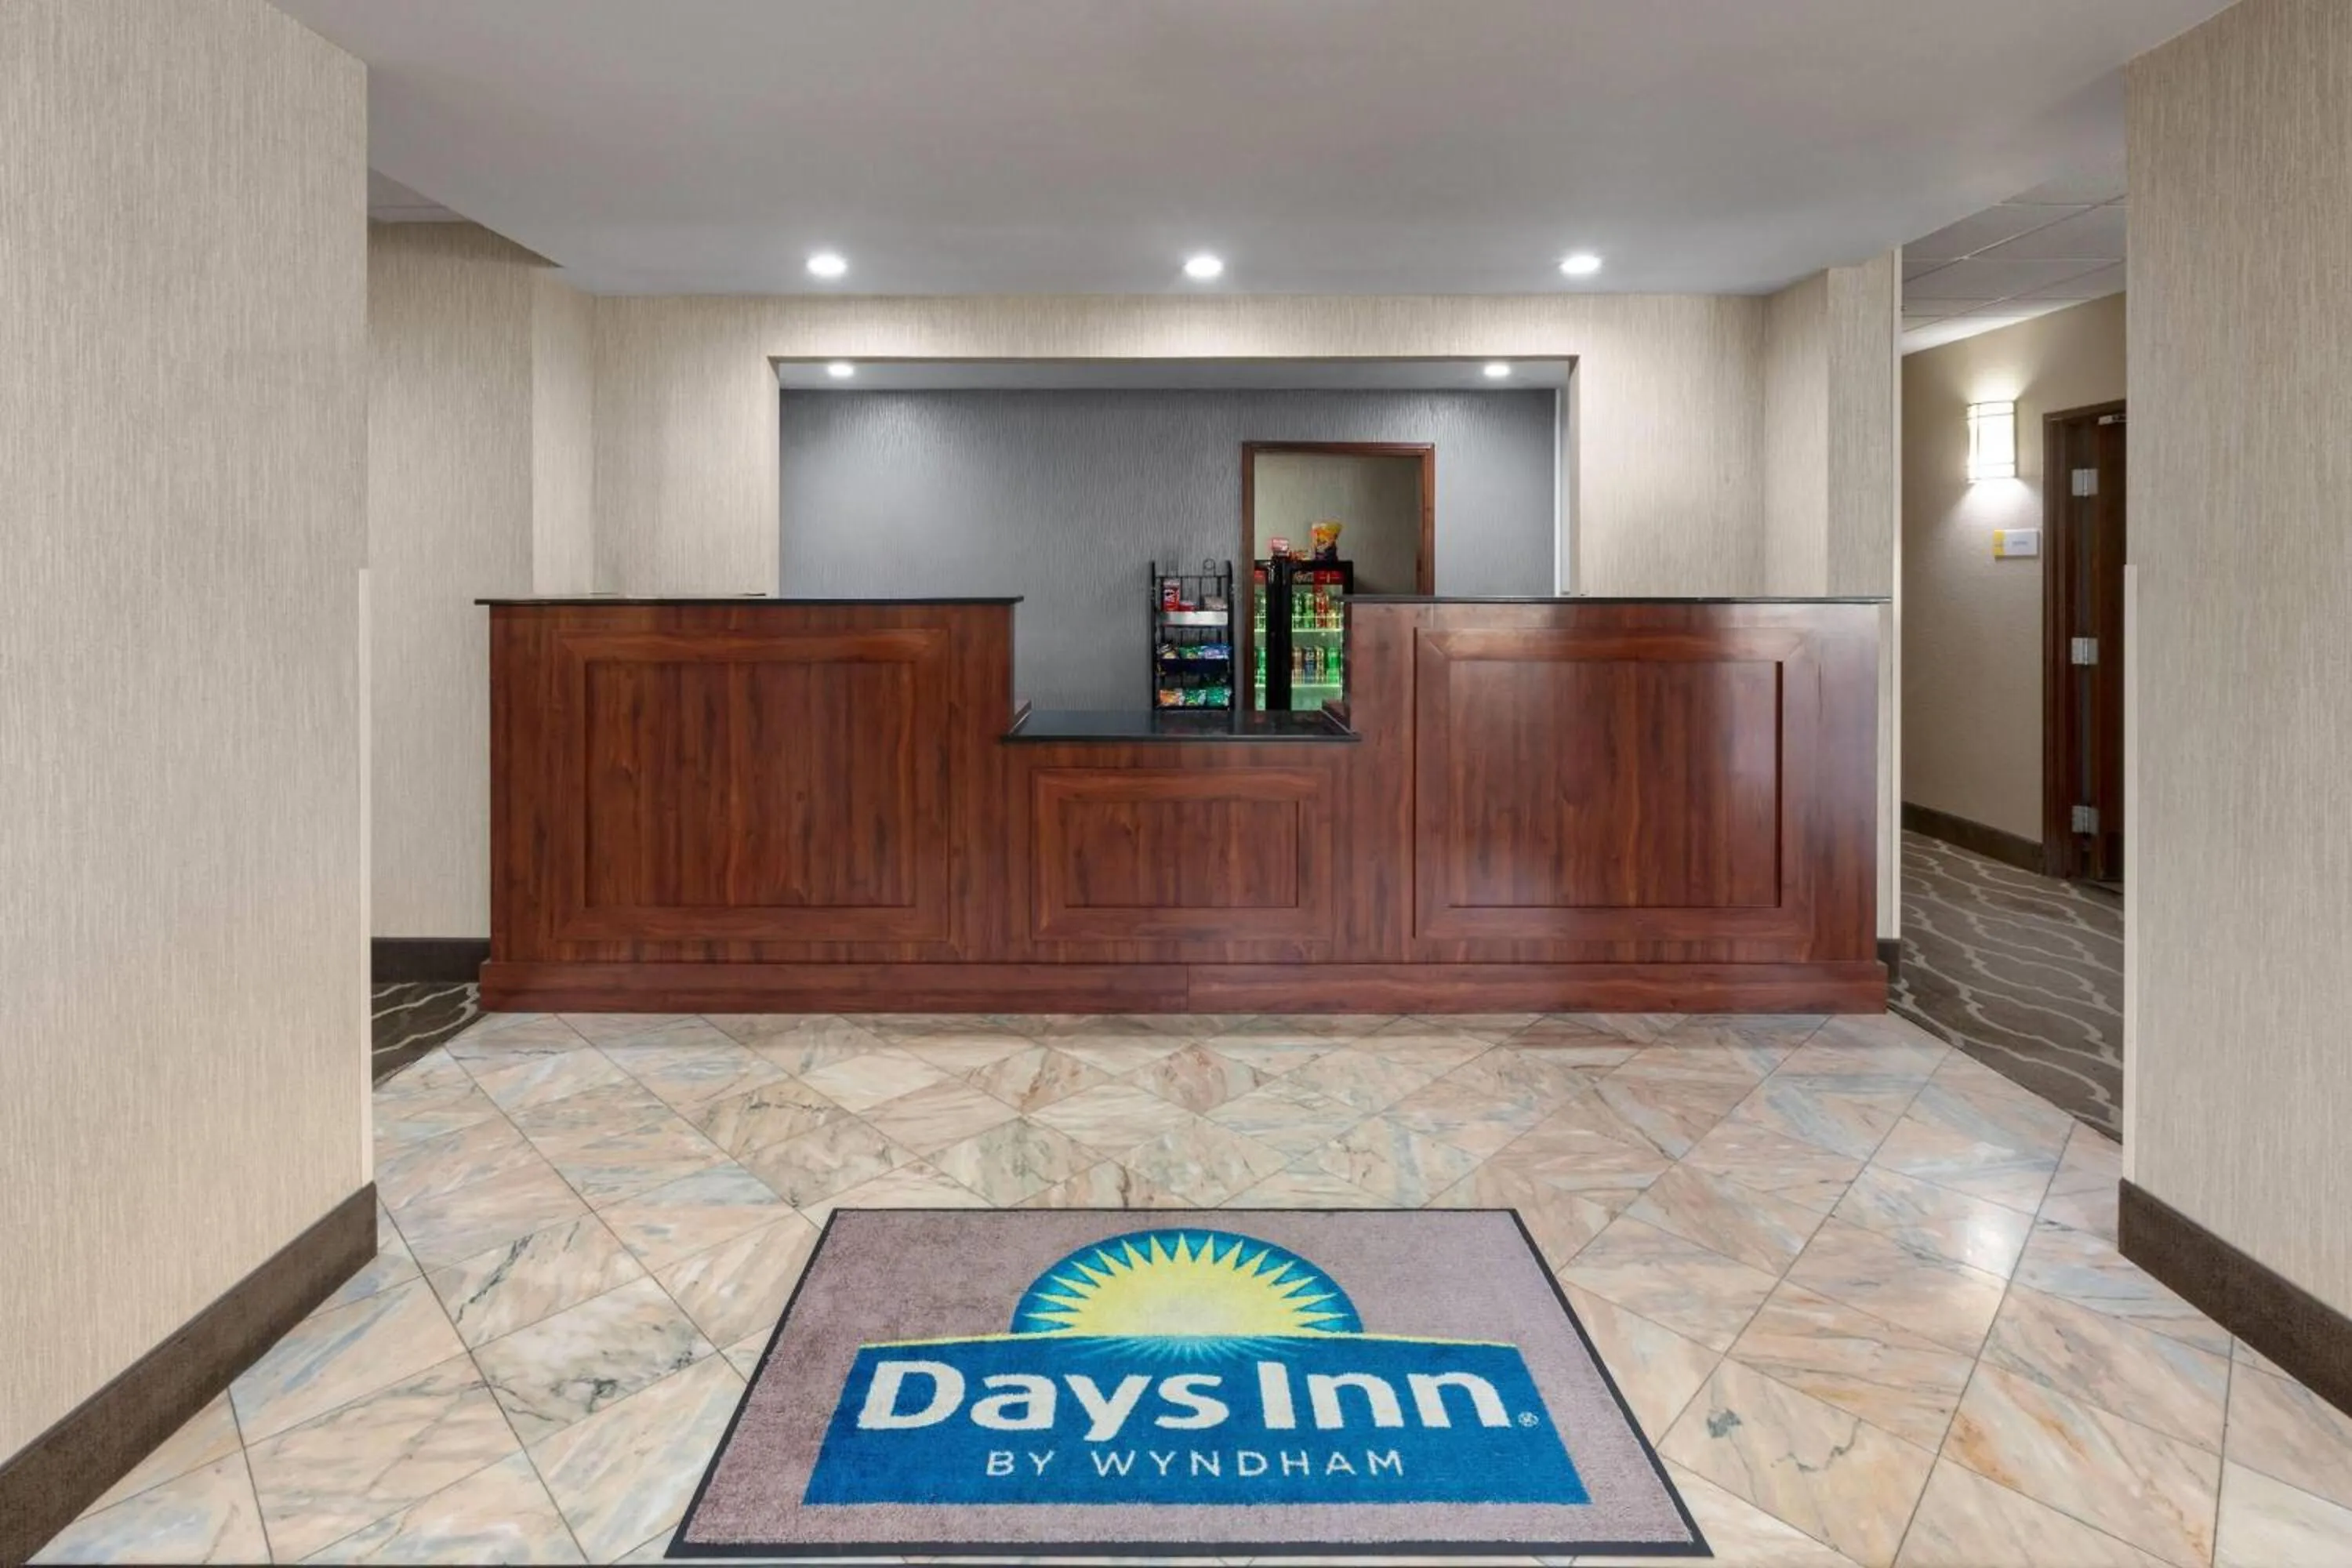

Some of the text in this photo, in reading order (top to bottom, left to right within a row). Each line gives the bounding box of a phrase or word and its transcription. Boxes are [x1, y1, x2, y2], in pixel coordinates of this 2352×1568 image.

[857, 1360, 1229, 1441] Days
[986, 1450, 1403, 1476] BY WYNDHAM
